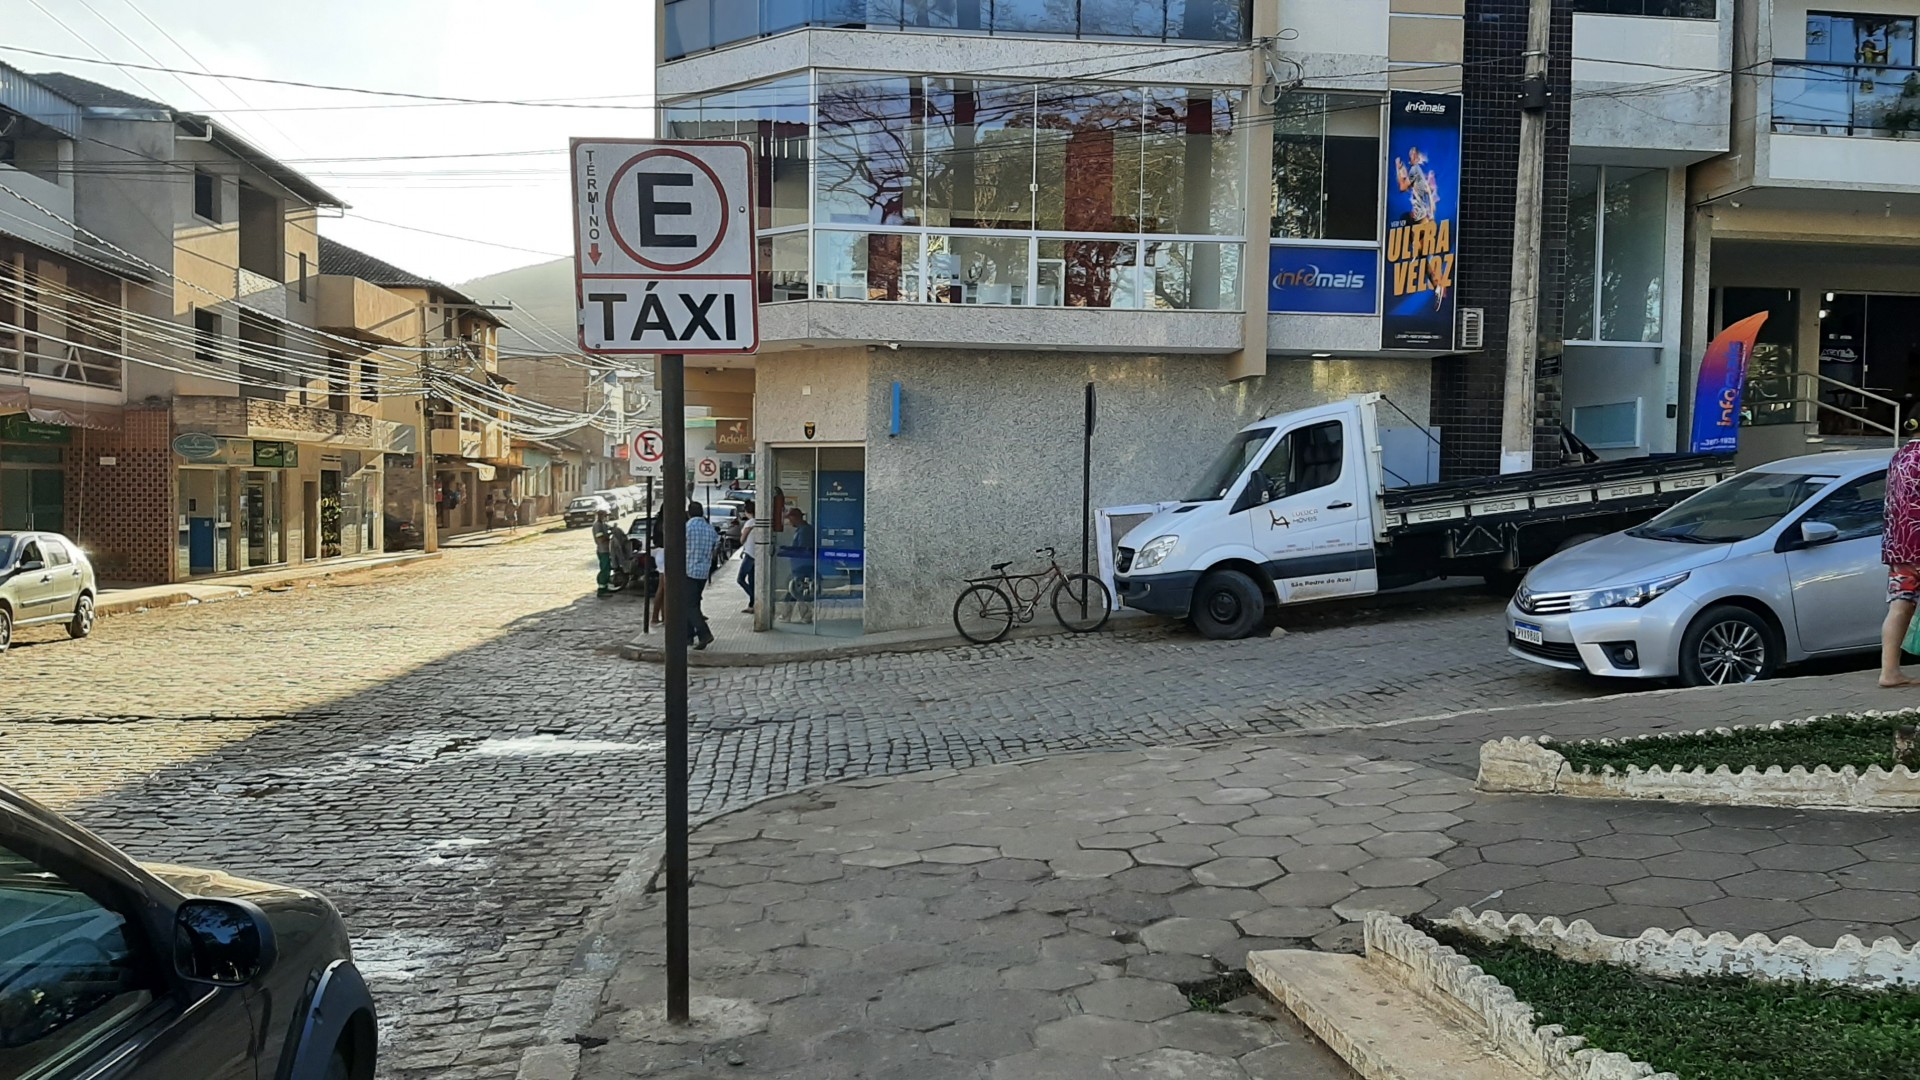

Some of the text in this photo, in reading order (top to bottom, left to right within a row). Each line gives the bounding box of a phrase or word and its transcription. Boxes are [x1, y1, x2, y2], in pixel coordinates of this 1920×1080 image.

[585, 150, 600, 240] TÉRMINO
[637, 172, 697, 248] E
[1387, 219, 1450, 262] ULTRA
[1272, 264, 1365, 290] infomais
[1393, 253, 1455, 296] VELOZ
[588, 280, 737, 341] TÁXI
